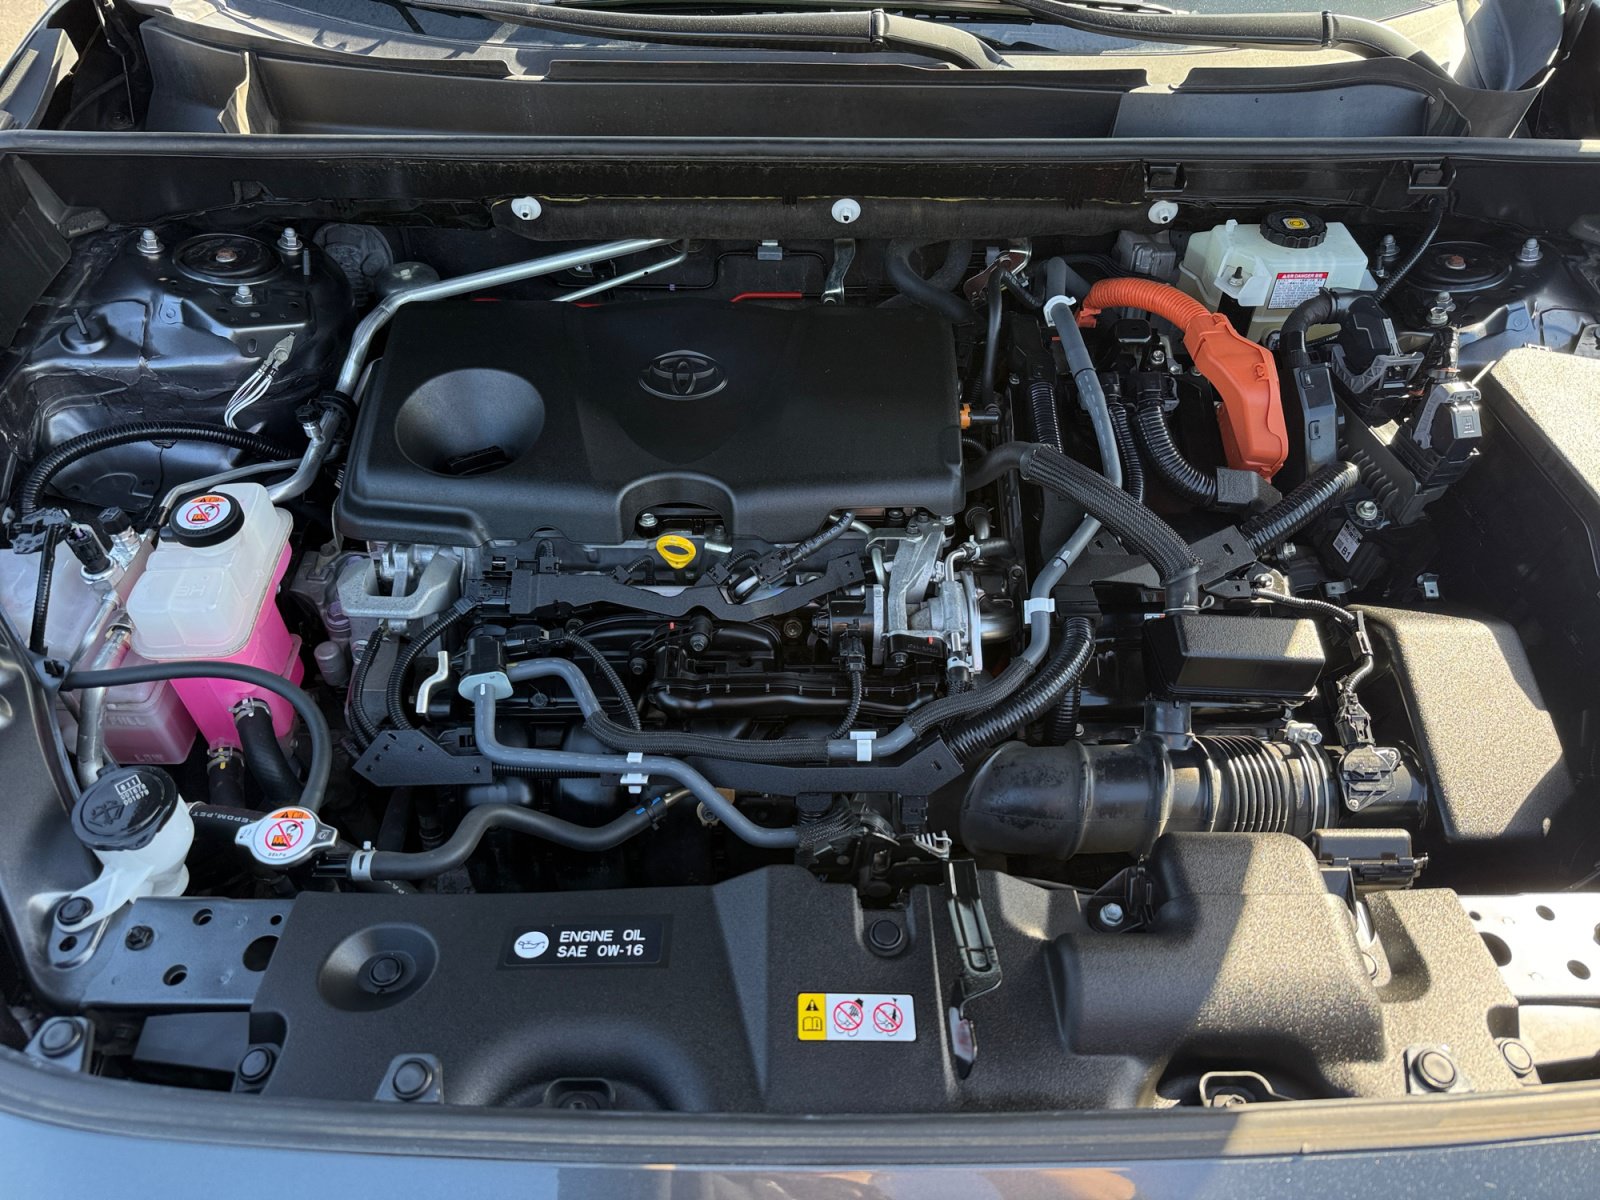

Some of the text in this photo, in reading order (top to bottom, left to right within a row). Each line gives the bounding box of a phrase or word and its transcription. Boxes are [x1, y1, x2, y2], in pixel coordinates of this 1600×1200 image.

[559, 929, 646, 943] ENGINE OIL
[556, 944, 644, 957] SAE 0W-16
